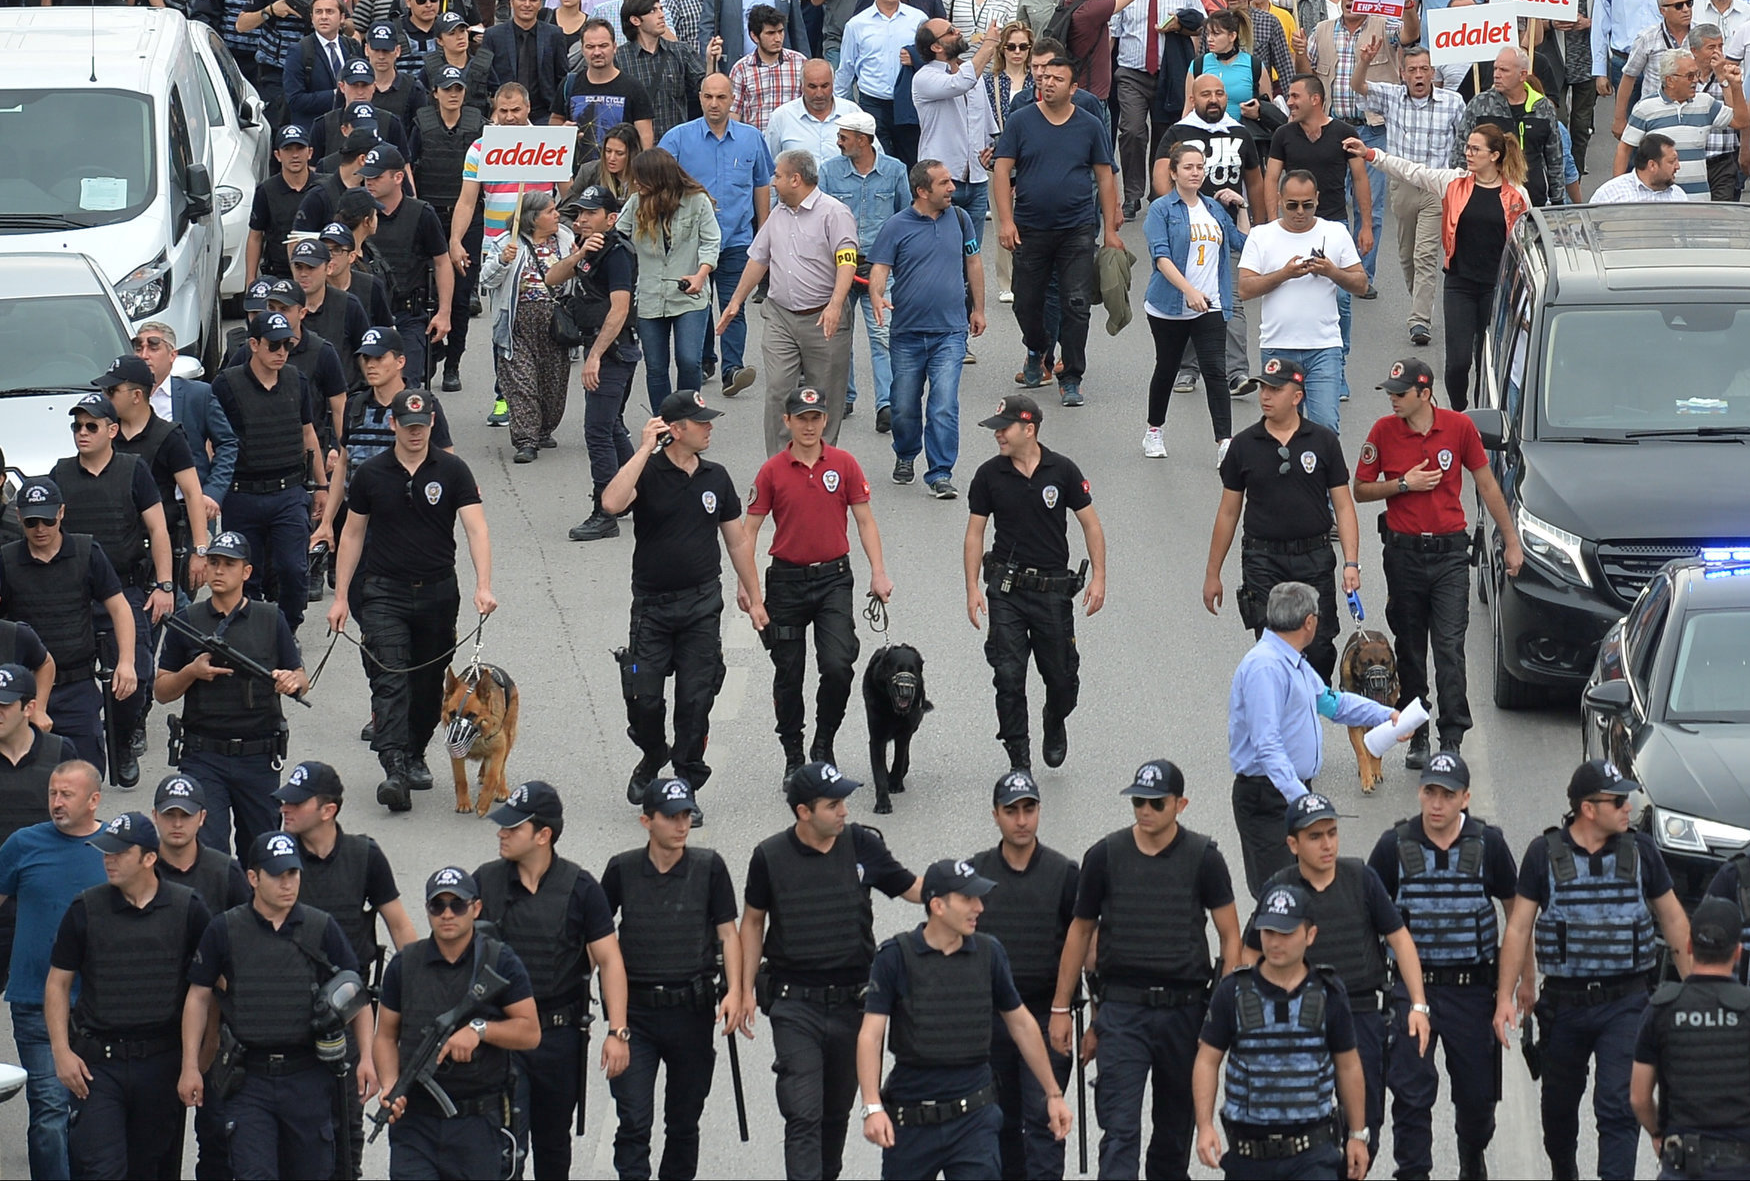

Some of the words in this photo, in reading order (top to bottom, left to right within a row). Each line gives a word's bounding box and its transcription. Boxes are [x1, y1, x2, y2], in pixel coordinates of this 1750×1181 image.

[1357, 3, 1373, 11] EHP
[1435, 21, 1511, 48] adalet
[485, 141, 568, 167] adalet
[1674, 1008, 1738, 1027] POLİS
